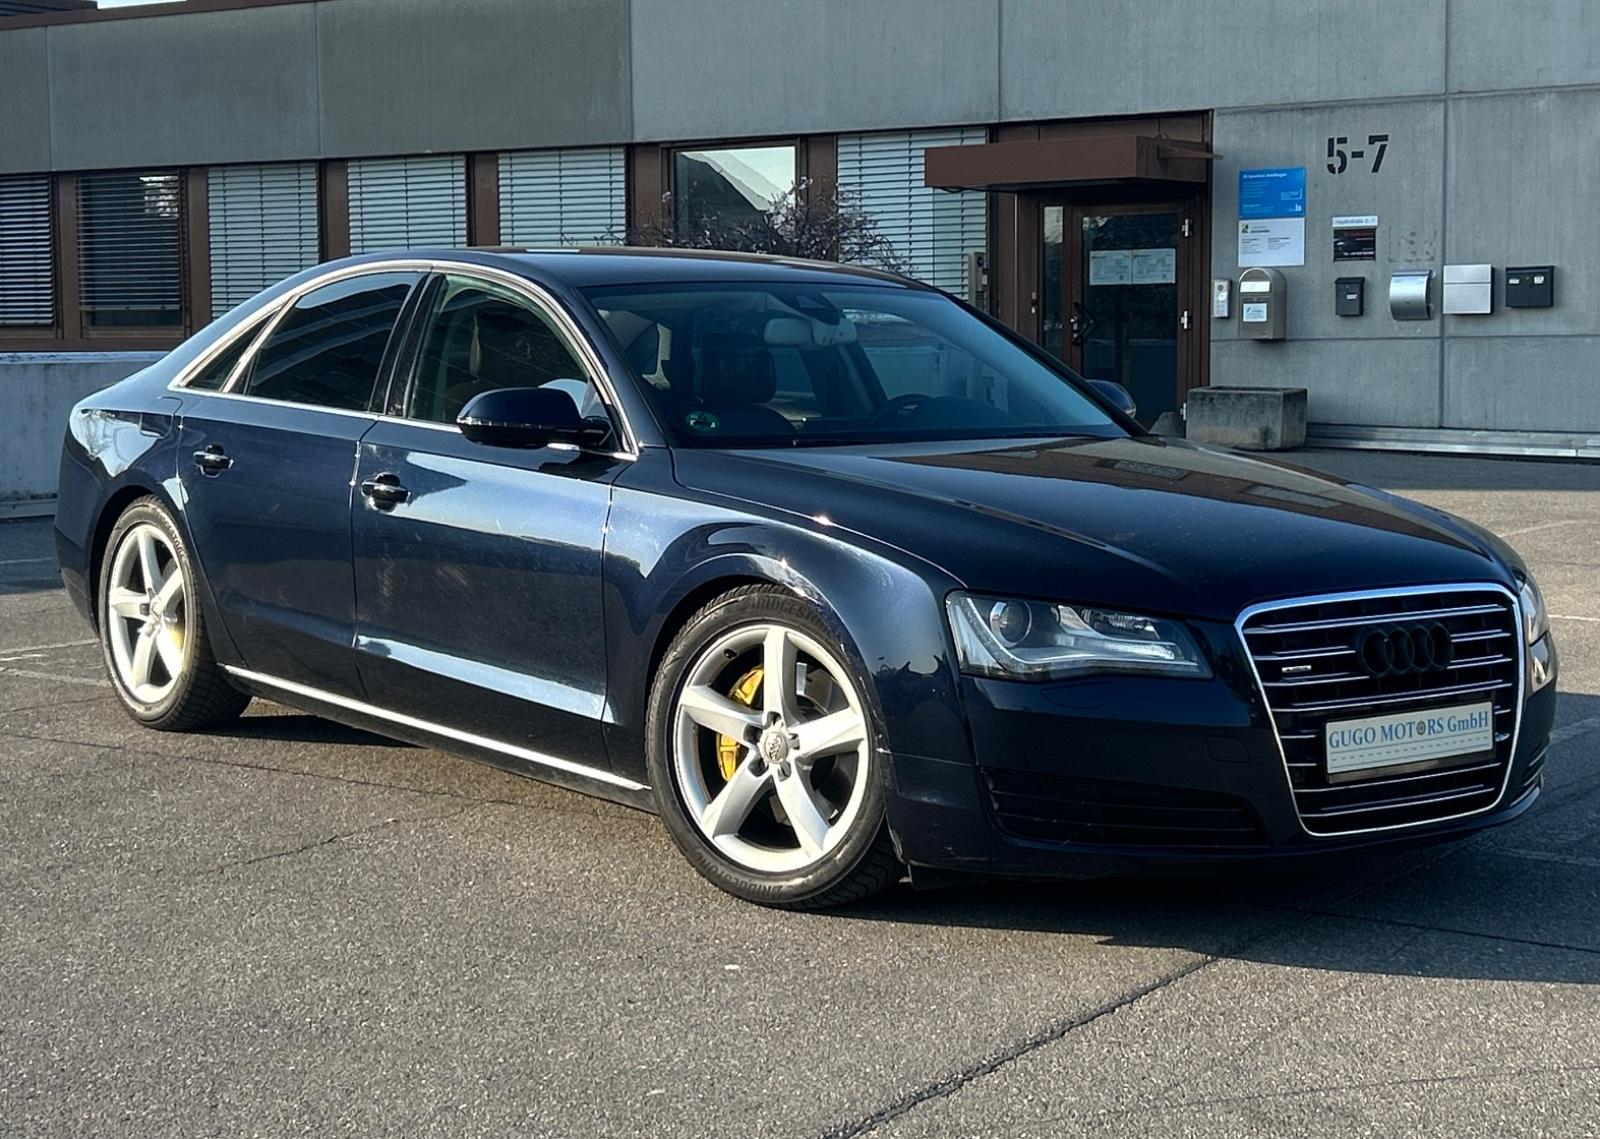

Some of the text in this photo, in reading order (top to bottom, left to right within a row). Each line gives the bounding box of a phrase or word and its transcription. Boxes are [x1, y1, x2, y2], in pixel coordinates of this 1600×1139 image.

[1327, 134, 1389, 175] 5-7
[1328, 711, 1488, 749] GUGO MOTORS GmbH
